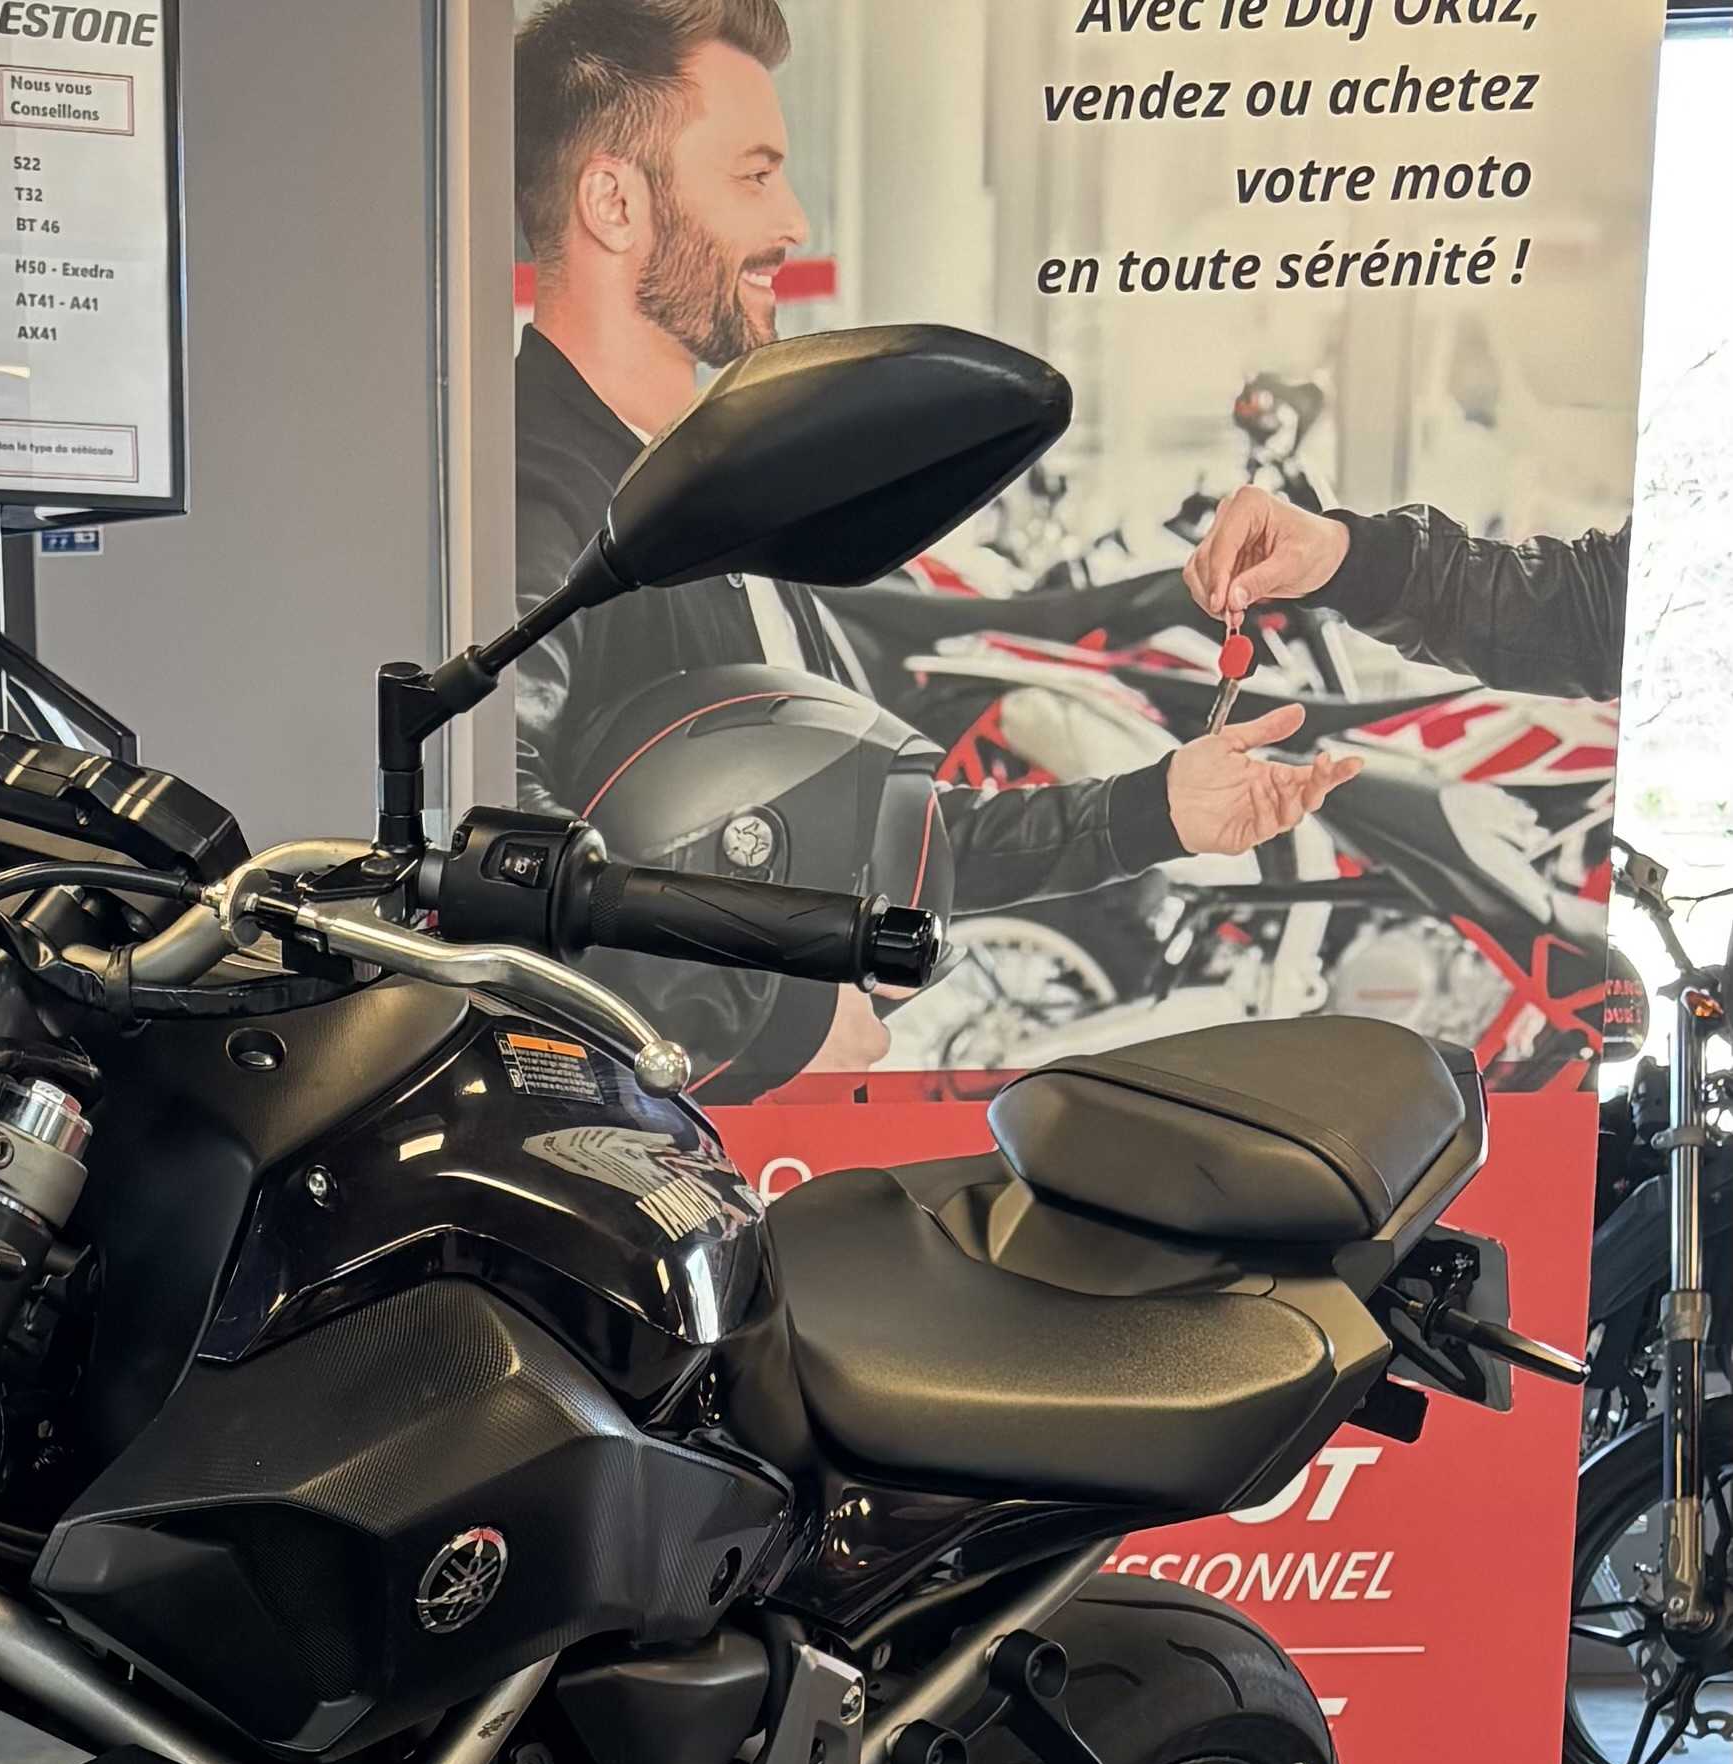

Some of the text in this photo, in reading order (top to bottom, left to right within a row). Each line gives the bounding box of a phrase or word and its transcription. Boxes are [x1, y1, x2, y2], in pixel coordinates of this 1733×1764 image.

[1076, 0, 1201, 32] Avec
[1220, 0, 1267, 29] le
[10, 75, 92, 96] Nous vous
[1044, 65, 1540, 121] vendez ou achetez
[10, 101, 100, 121] Conseillons
[14, 156, 41, 171] S22
[1236, 156, 1532, 203] votre moto
[15, 187, 43, 202] T32
[16, 217, 61, 234] BT 46
[15, 259, 47, 275] H50
[62, 263, 115, 279] Exedra
[1037, 257, 1100, 294] en
[1119, 248, 1261, 292] toute
[1276, 236, 1498, 289] sérénité
[16, 293, 55, 309] AT41
[70, 296, 99, 312] A41
[17, 326, 58, 341] AX41
